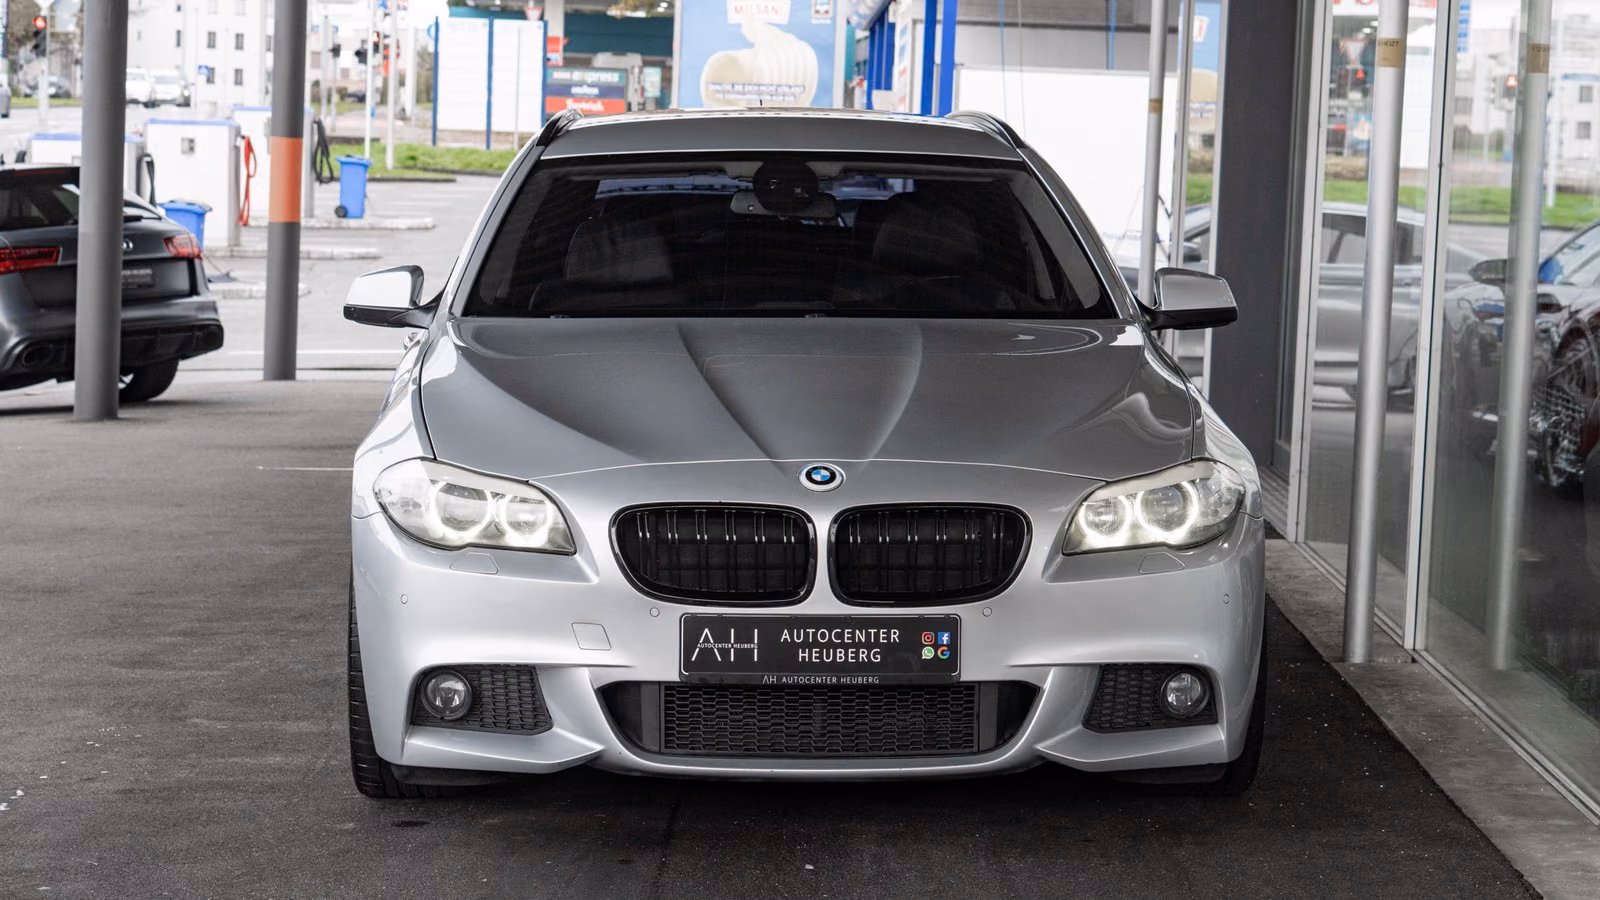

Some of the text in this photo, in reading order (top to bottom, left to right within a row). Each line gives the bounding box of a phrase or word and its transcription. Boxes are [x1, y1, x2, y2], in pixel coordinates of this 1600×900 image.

[734, 5, 783, 15] MILSANI
[781, 629, 899, 642] AUTOCENTER
[691, 628, 758, 661] AH
[798, 649, 881, 662] HEUBERG
[763, 675, 879, 684] AH AUTOCENTER HEUBERG
